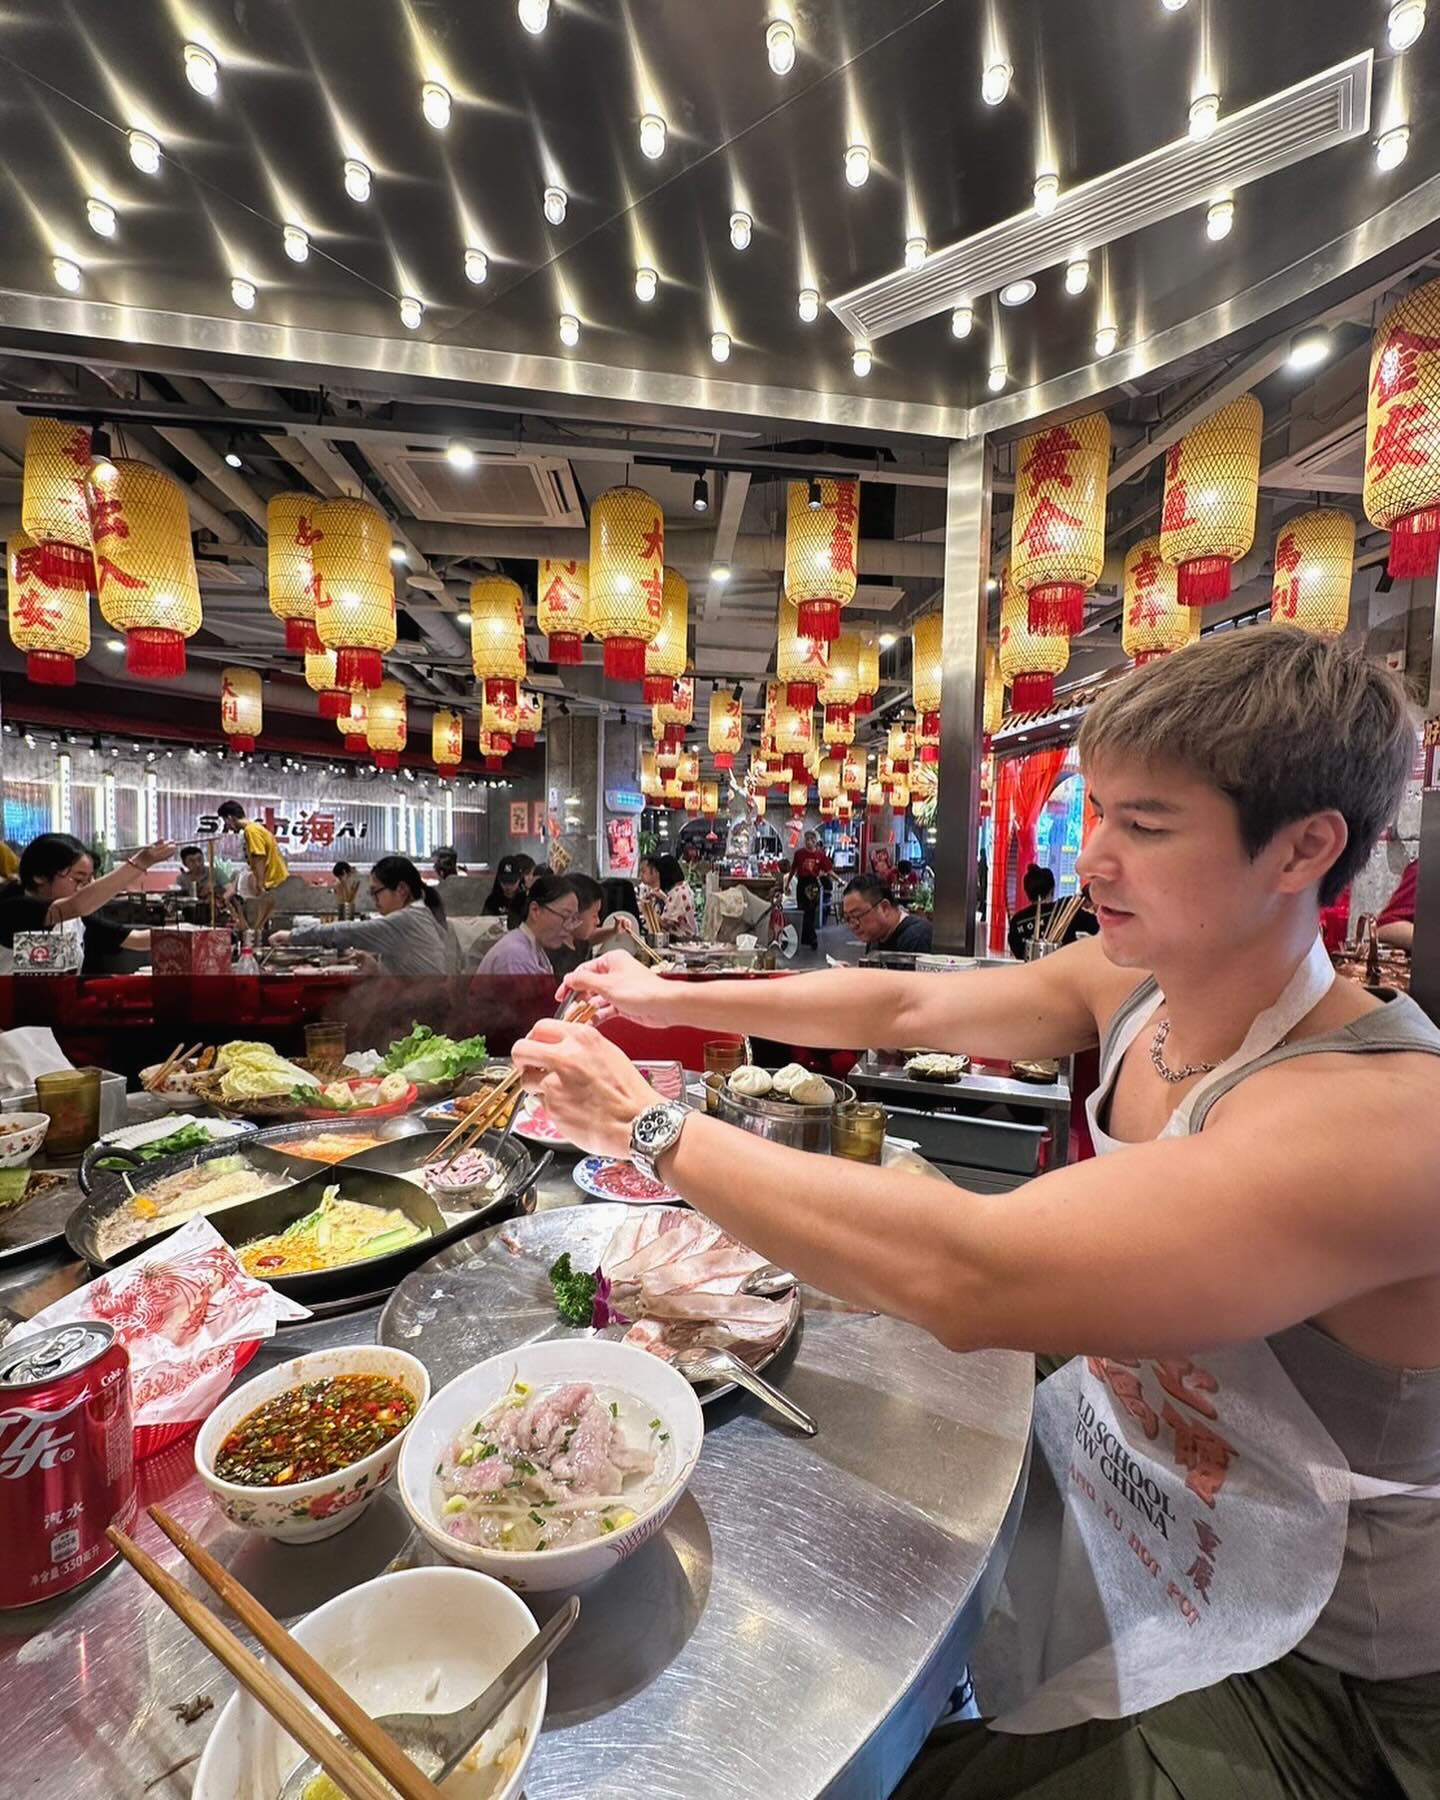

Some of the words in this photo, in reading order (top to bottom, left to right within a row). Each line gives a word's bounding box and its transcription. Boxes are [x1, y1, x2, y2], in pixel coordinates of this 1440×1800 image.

[637, 517, 664, 620] 大吉
[1129, 551, 1169, 629] 吉祥
[1094, 1421, 1176, 1522] SCHOOL
[1100, 1454, 1169, 1541] CHINA
[44, 1501, 84, 1529] 汽水
[1102, 1500, 1124, 1532] YU
